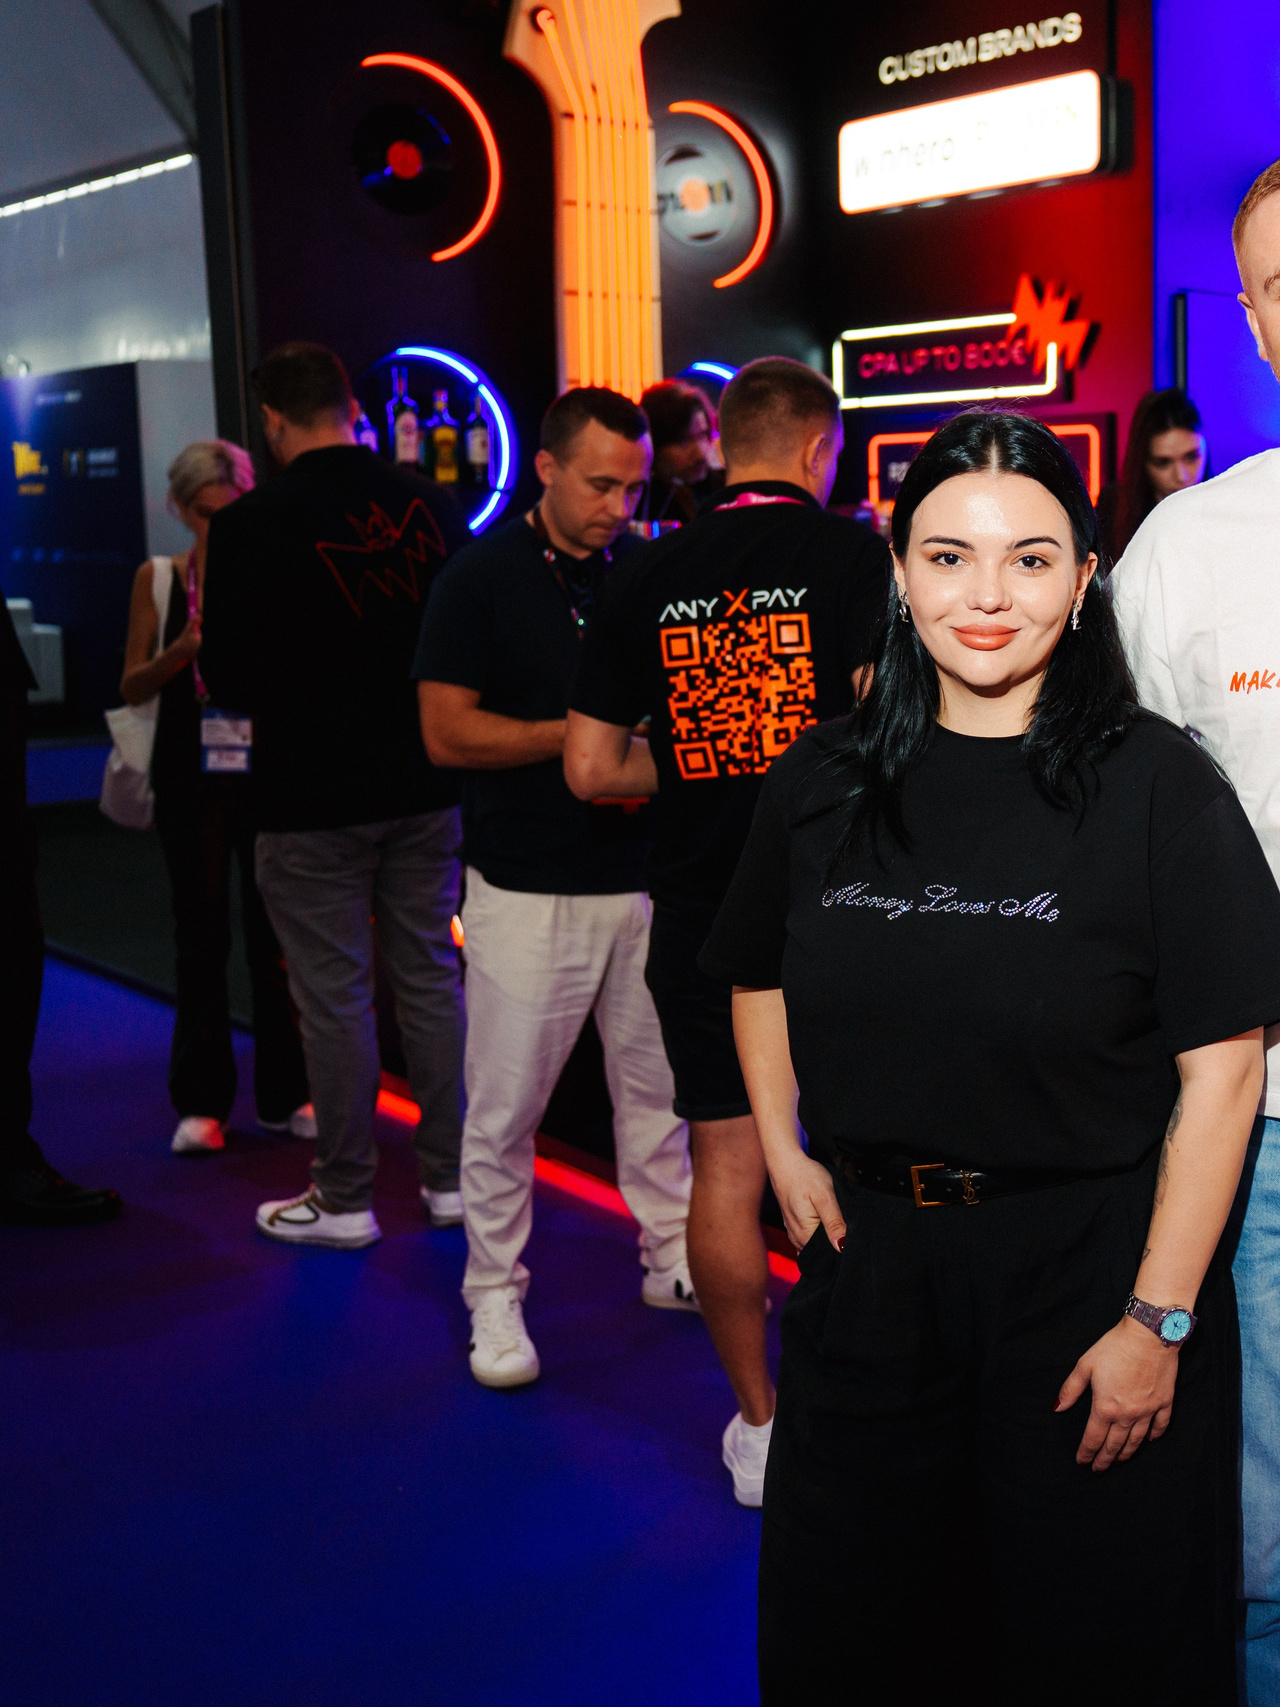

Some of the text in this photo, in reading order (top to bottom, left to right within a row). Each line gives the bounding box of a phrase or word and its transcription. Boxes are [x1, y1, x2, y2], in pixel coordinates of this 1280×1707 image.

[878, 12, 1083, 85] CUSTOM BRANDS
[859, 352, 898, 378] CPA
[902, 348, 929, 374] UP
[931, 345, 961, 371] TO
[658, 587, 808, 623] ANY X PAY
[822, 881, 1060, 922] Money Loves Me
